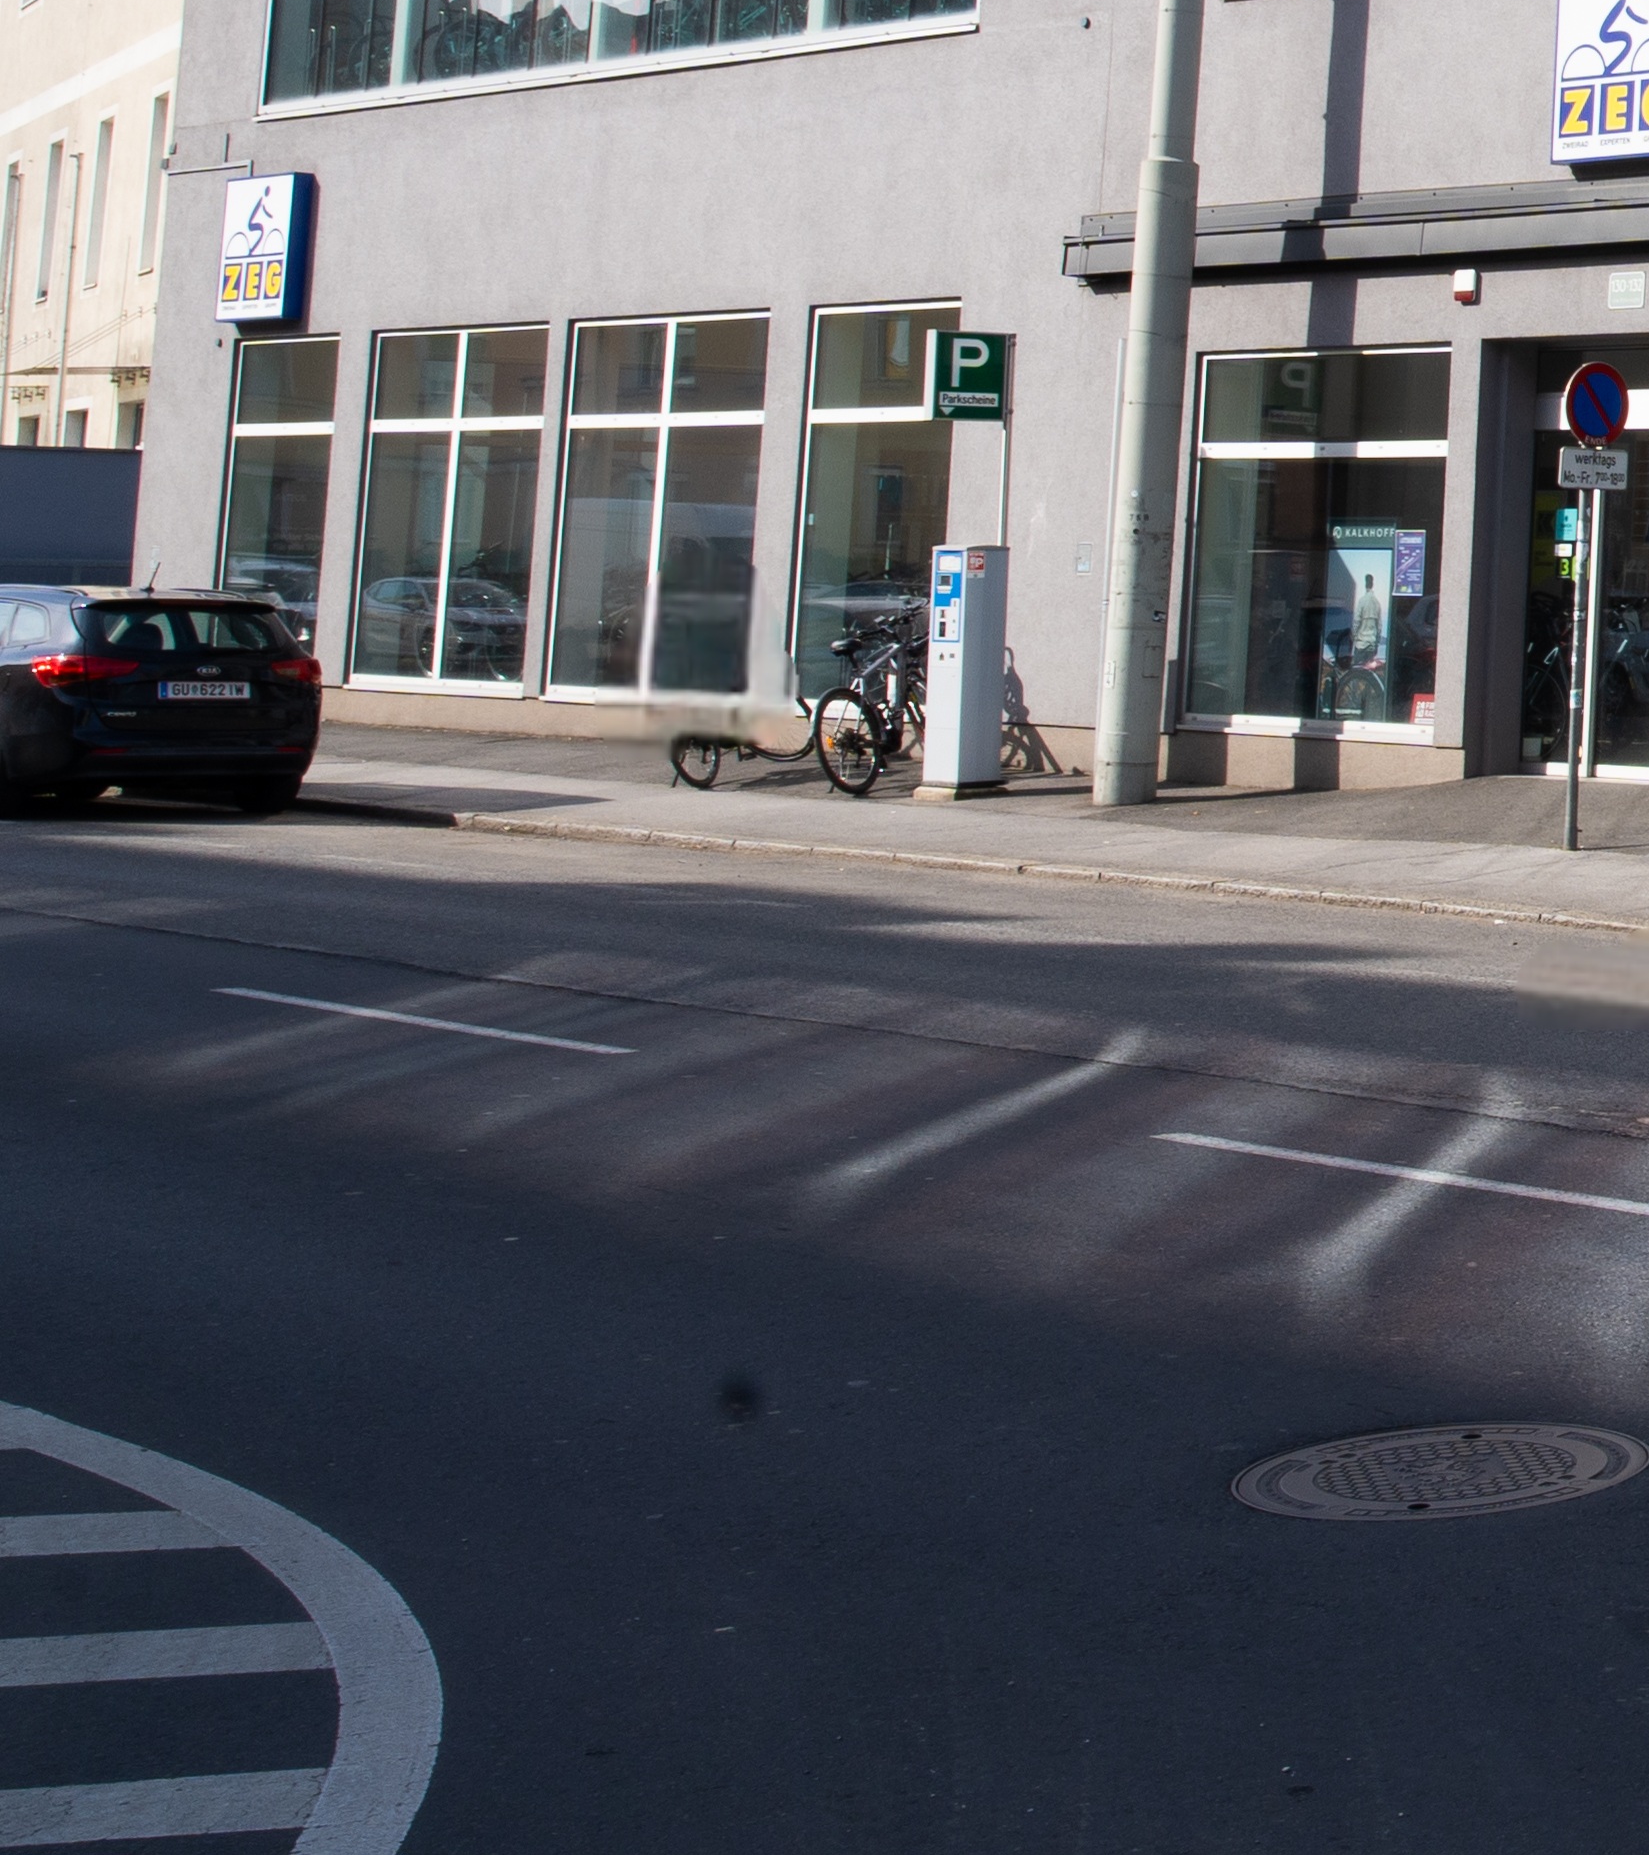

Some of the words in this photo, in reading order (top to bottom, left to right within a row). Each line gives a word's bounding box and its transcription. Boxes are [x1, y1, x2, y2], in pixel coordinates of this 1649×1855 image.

[1562, 140, 1588, 149] ZWEIRAD
[1600, 137, 1630, 146] EXPERTEN
[222, 261, 282, 301] ZEG
[951, 338, 990, 388] P
[942, 393, 996, 405] Parkscheine
[1585, 435, 1607, 445] ENDE
[1575, 452, 1616, 469] werktags
[1345, 528, 1395, 538] KALKHOFF
[202, 667, 217, 675] KIA
[172, 683, 190, 696] GU
[200, 683, 226, 696] 622
[229, 683, 245, 696] IW
